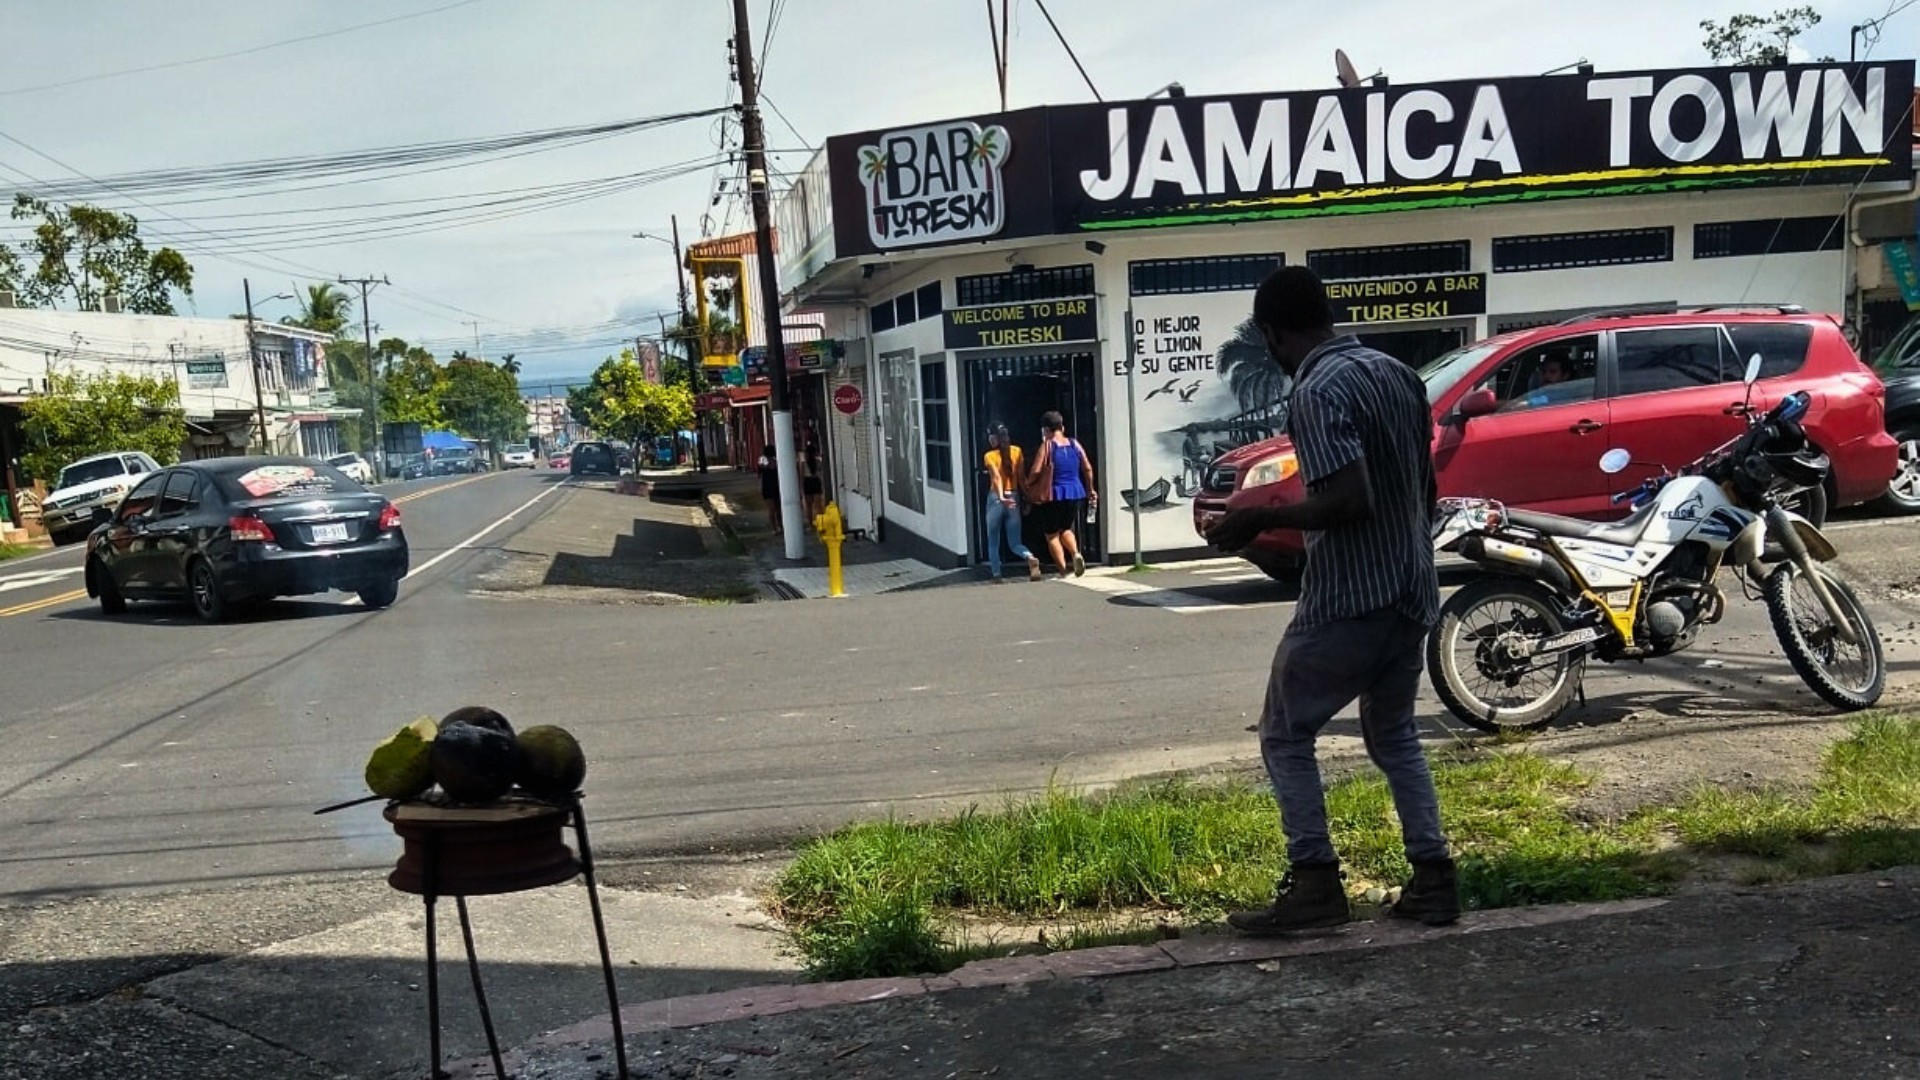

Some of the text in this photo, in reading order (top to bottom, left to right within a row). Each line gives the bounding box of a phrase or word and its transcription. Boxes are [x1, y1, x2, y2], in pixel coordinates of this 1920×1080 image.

[1079, 66, 1887, 201] JAMAICA TOWN
[886, 127, 979, 201] BAR
[873, 191, 995, 240] TURESKI
[1326, 275, 1480, 299] IENVENIDO A BAR
[952, 300, 1087, 325] WELCOME TO BAR
[1346, 299, 1449, 323] TURESKI
[977, 324, 1063, 347] TURESKI
[1154, 315, 1200, 334] MEJOR
[1154, 335, 1202, 354] LIMON
[1141, 357, 1160, 375] SU
[1168, 354, 1215, 374] GENTE
